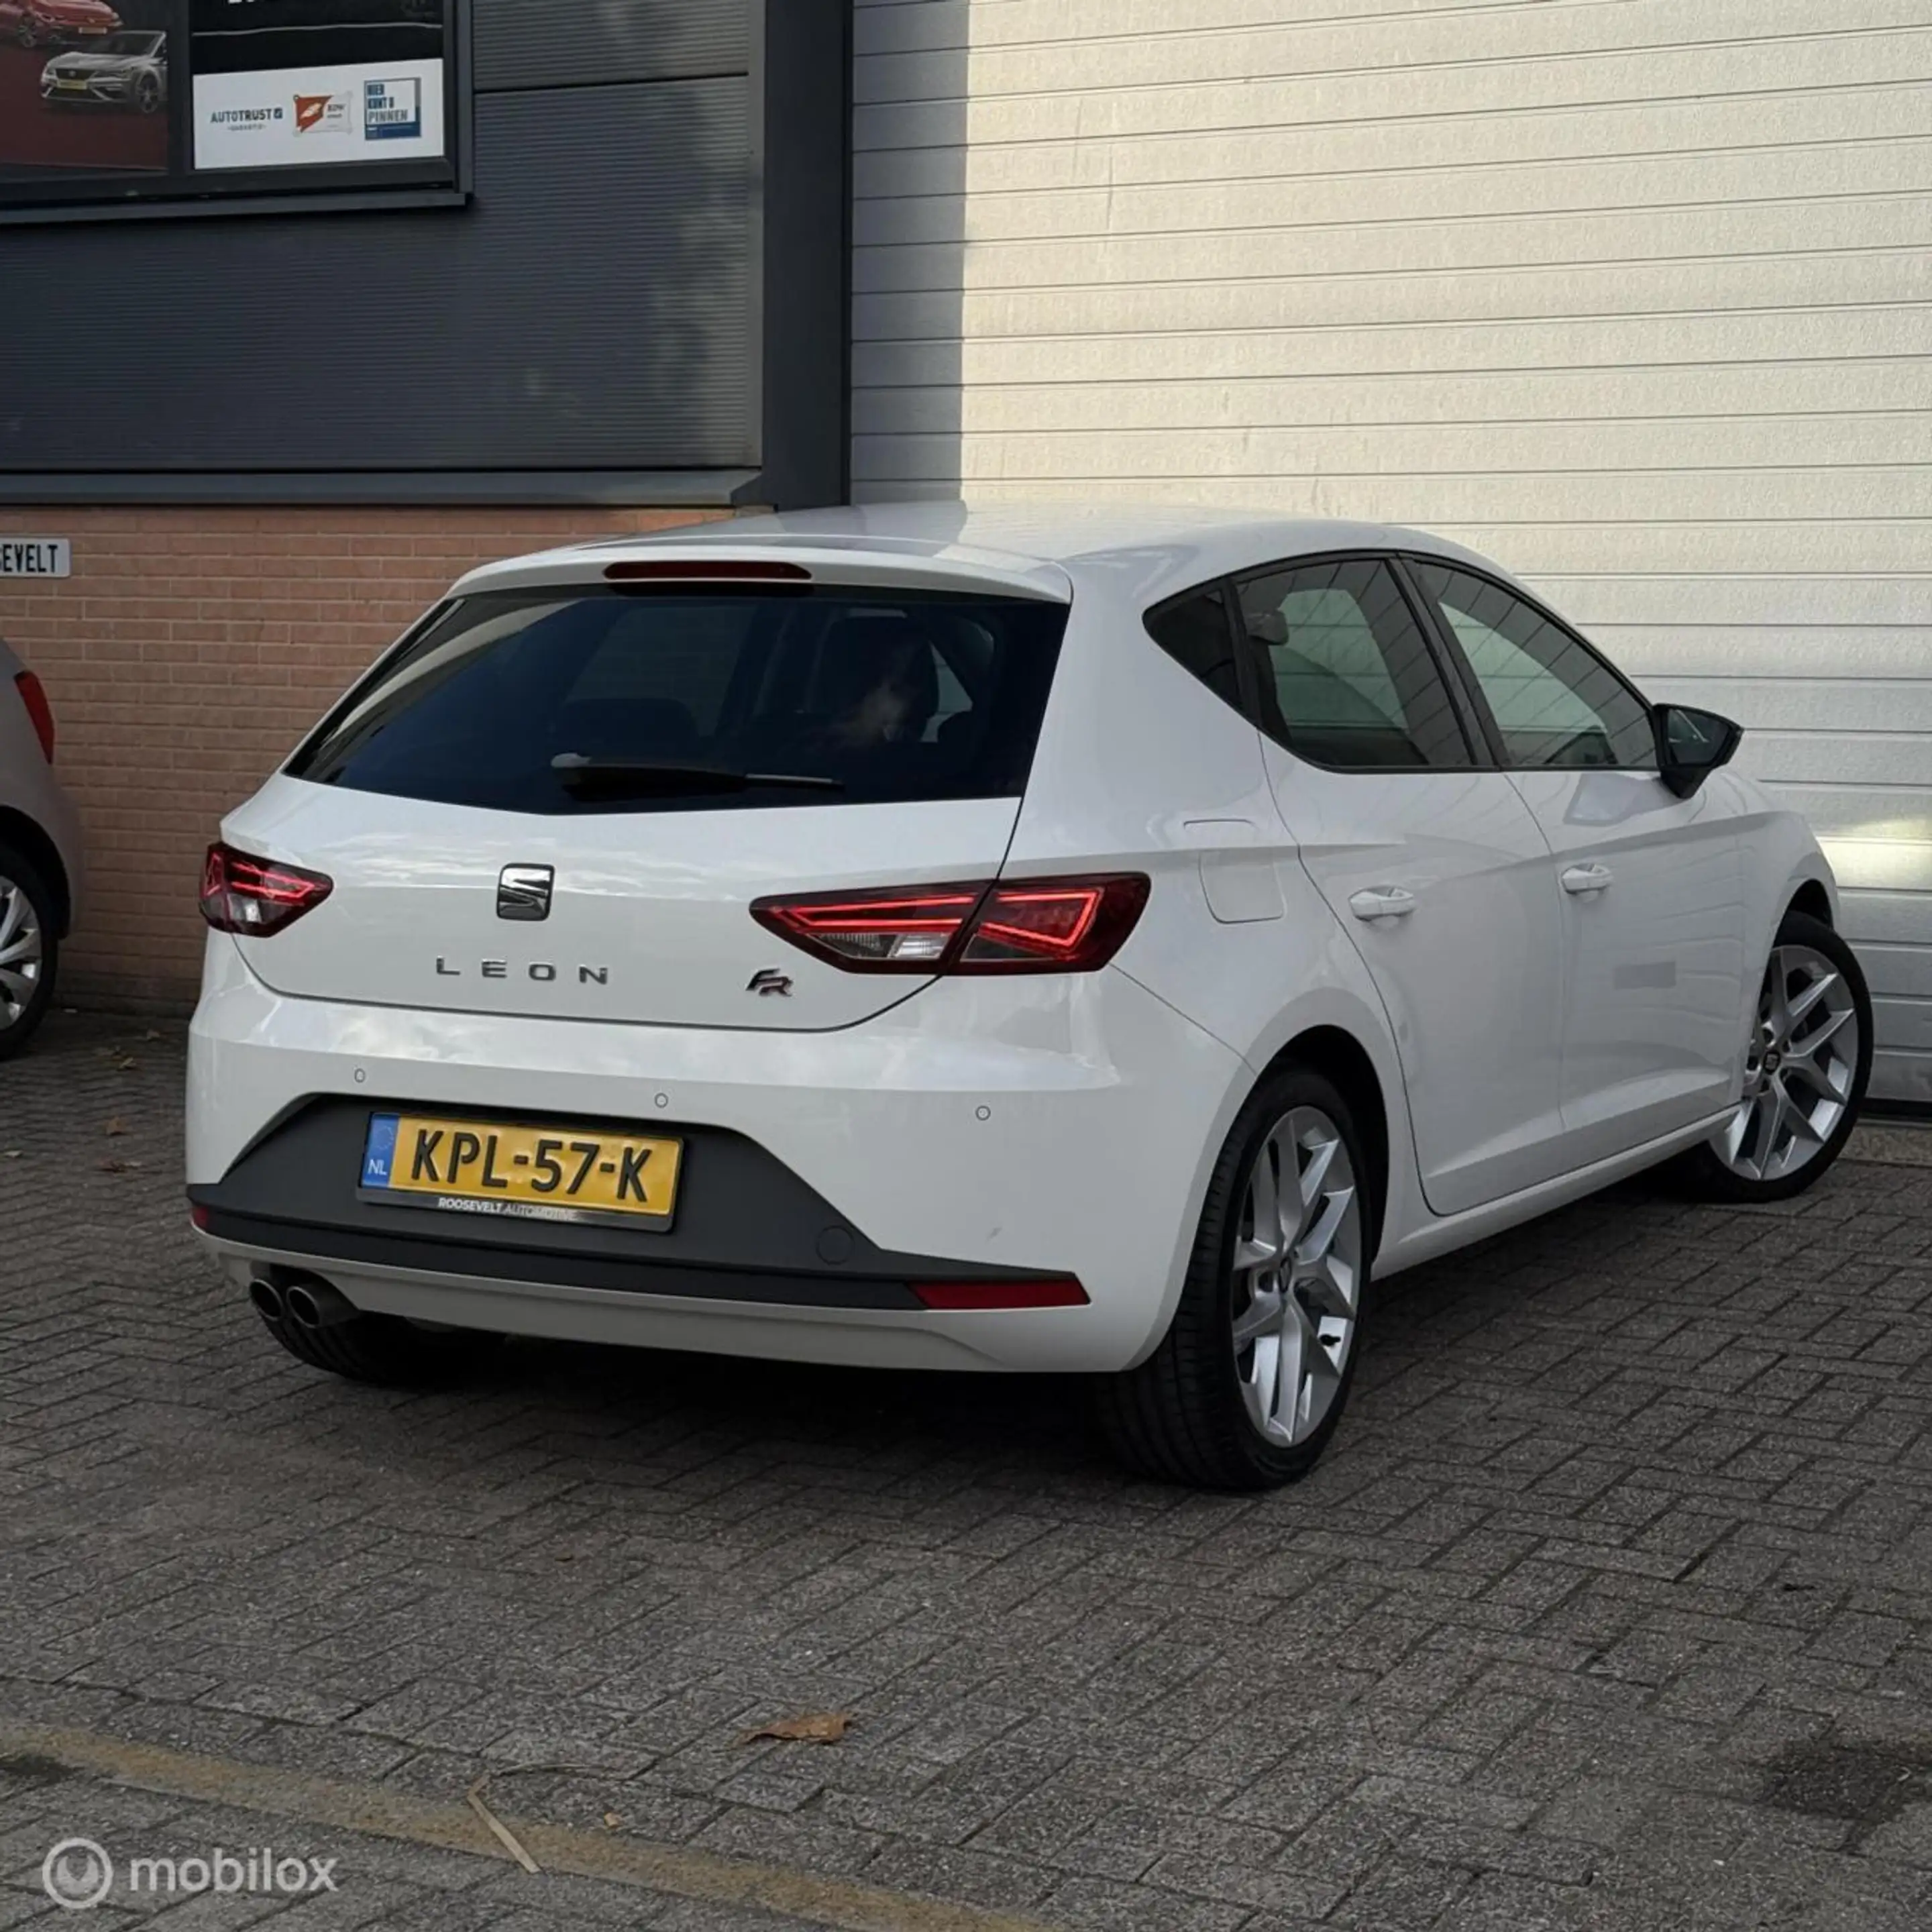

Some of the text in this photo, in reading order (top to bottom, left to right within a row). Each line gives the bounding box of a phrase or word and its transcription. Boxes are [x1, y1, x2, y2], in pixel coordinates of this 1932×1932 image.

[210, 109, 272, 123] AUTOTRUST
[368, 109, 408, 123] PINNEN
[436, 957, 608, 985] LEON
[745, 968, 794, 998] FR
[368, 1159, 388, 1176] NL
[411, 1128, 653, 1203] KPL-57-K
[437, 1197, 503, 1215] ROOSEVELT
